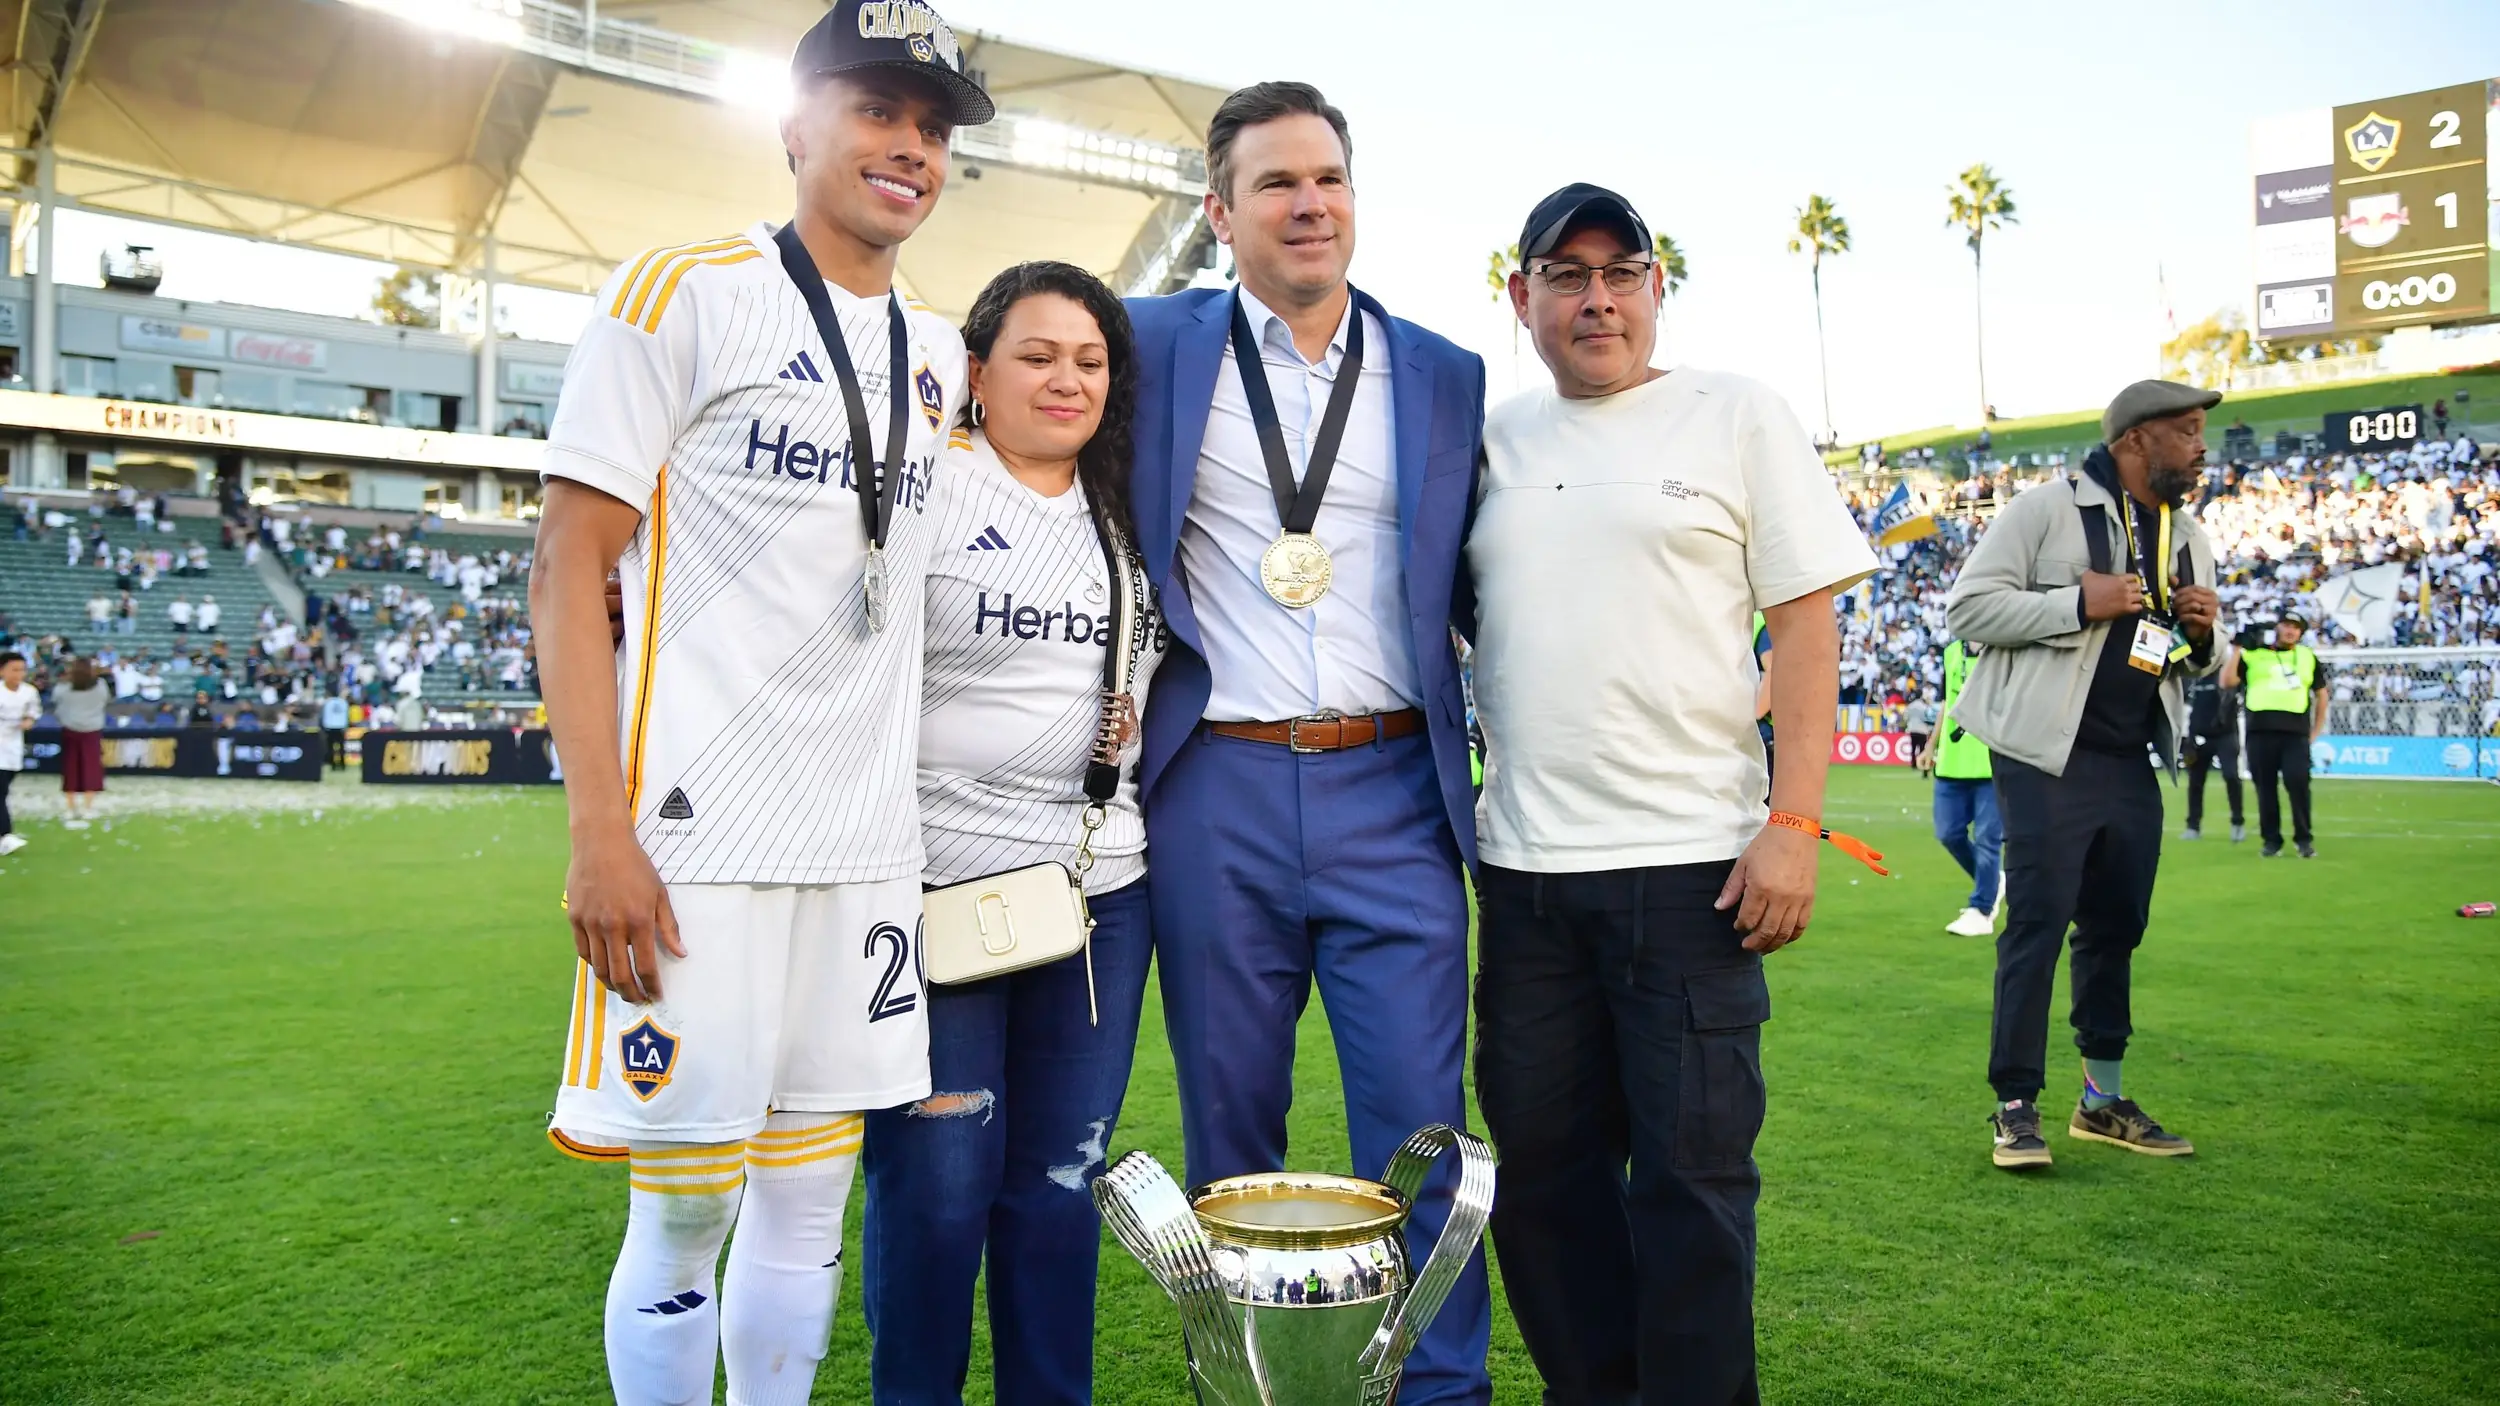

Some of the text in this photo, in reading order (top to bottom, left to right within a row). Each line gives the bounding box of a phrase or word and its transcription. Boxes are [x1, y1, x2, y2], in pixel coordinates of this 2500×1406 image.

[2357, 131, 2390, 151] LA
[2428, 110, 2462, 149] 2
[2434, 192, 2458, 229] 1
[2362, 272, 2457, 310] 0:00
[921, 384, 941, 409] LA
[105, 406, 236, 438] CHAMPIONS
[2349, 410, 2417, 444] 0:00
[1661, 490, 1687, 501] HOME
[1682, 488, 1700, 498] OUR
[1132, 567, 1144, 604] MARC
[2338, 746, 2394, 765] AT&T
[1769, 813, 1804, 828] MATC
[628, 1045, 664, 1070] LA
[625, 1072, 665, 1081] GALAXY
[1364, 1376, 1392, 1400] MLS
